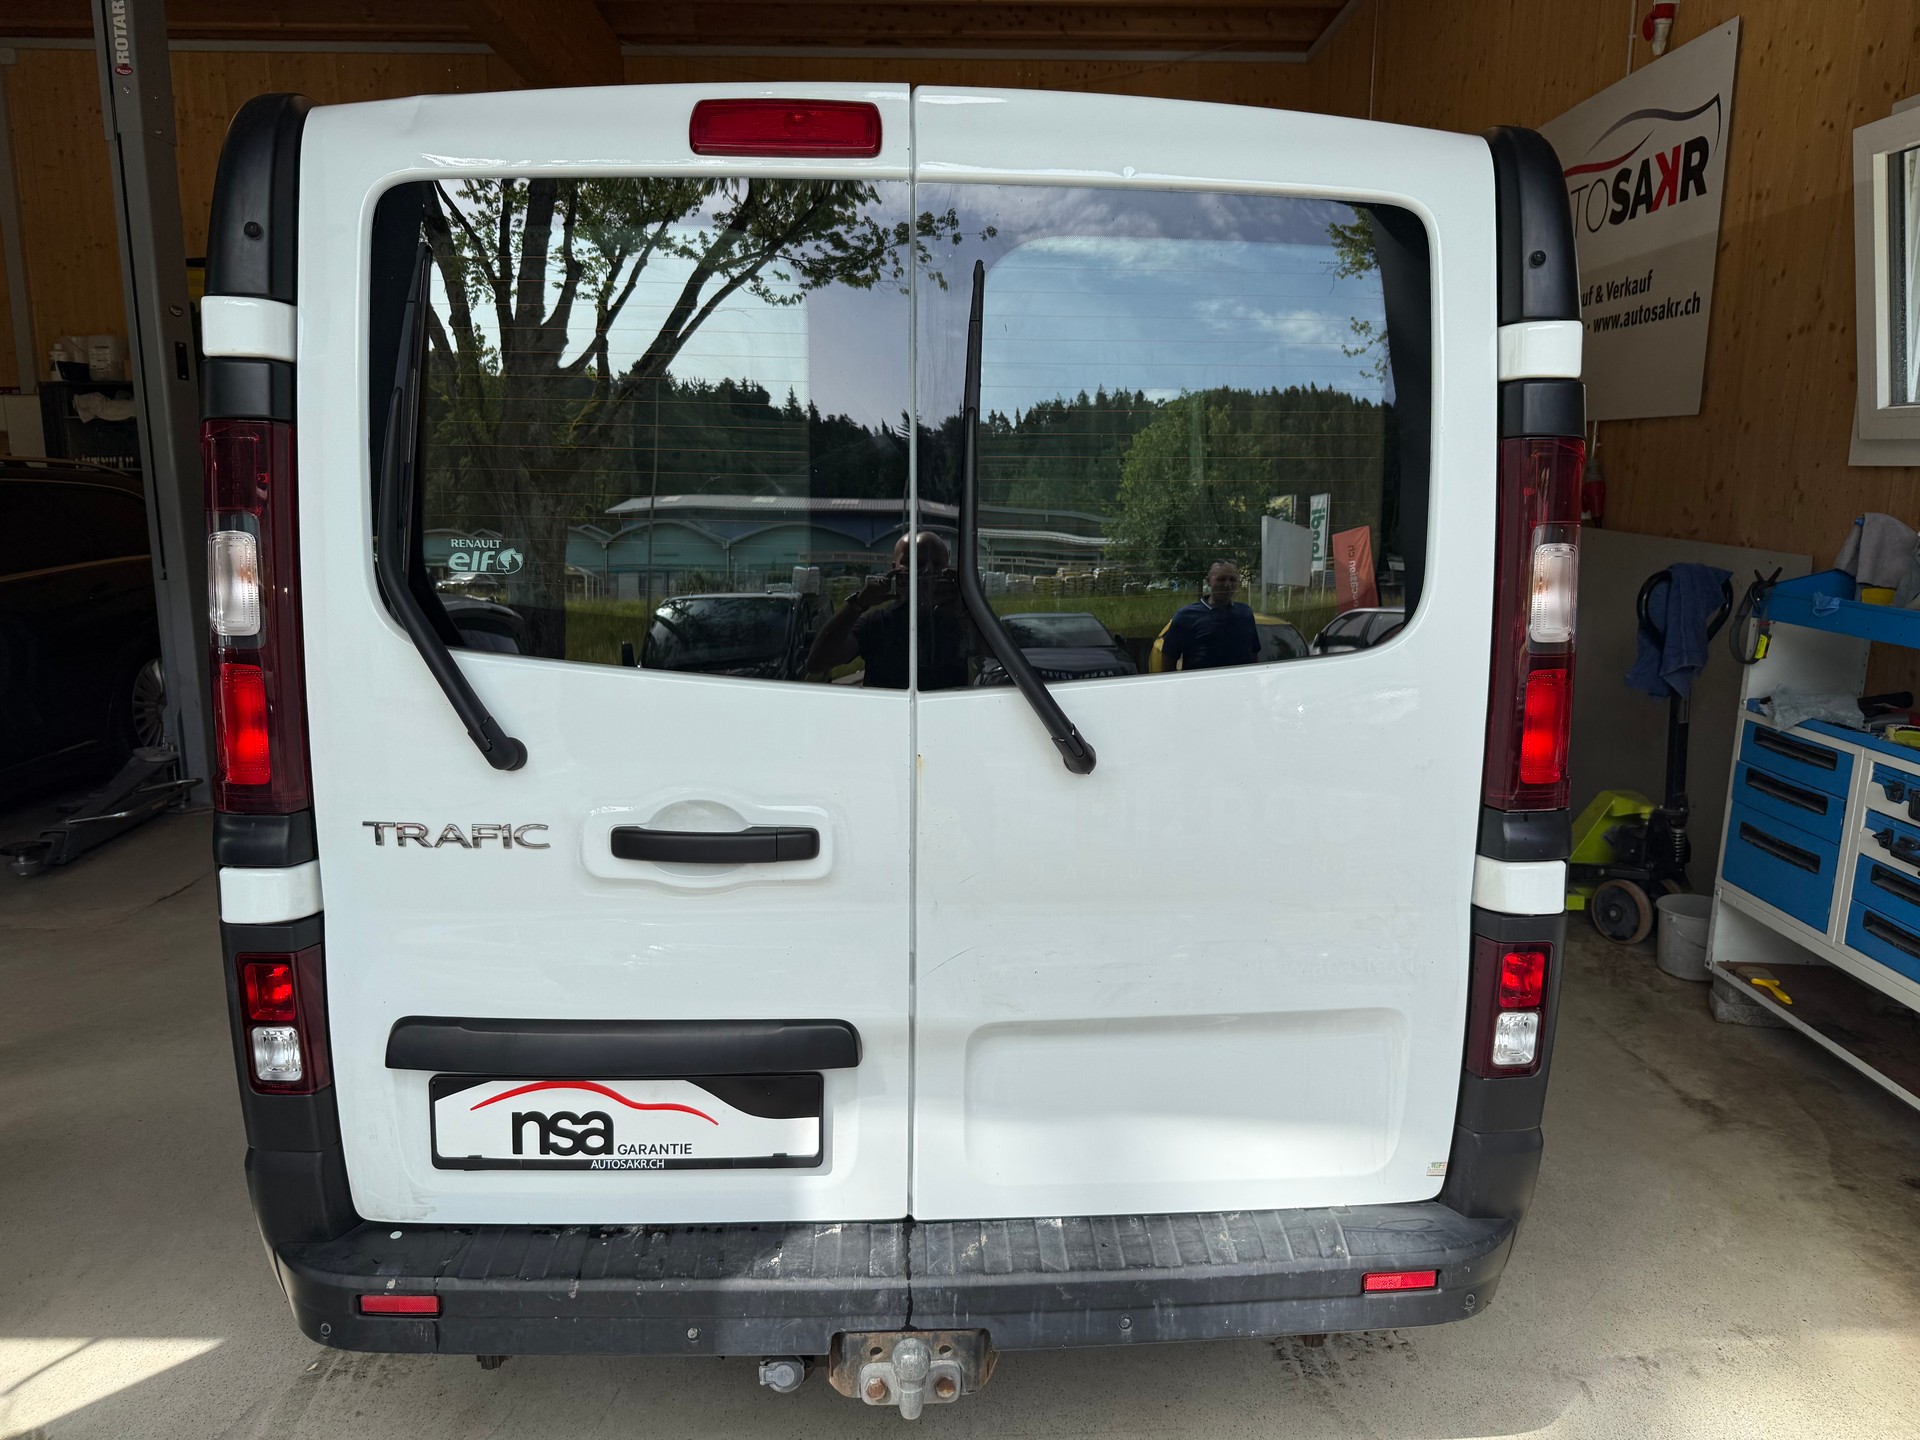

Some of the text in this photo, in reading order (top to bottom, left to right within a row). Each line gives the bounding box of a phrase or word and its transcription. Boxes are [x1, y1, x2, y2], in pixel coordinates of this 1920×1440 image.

[112, 0, 130, 64] ROTAR
[1571, 136, 1709, 238] TOSAKR
[1595, 285, 1604, 304] &
[1606, 269, 1653, 302] Verkauf
[1593, 291, 1701, 333] www.autosakr.ch
[448, 551, 496, 572] elf
[451, 539, 502, 549] RENAULT
[362, 821, 551, 849] TRAFIC
[512, 1111, 693, 1156] nsa GARANTIE
[590, 1159, 665, 1169] AUTOSAKR.CH
